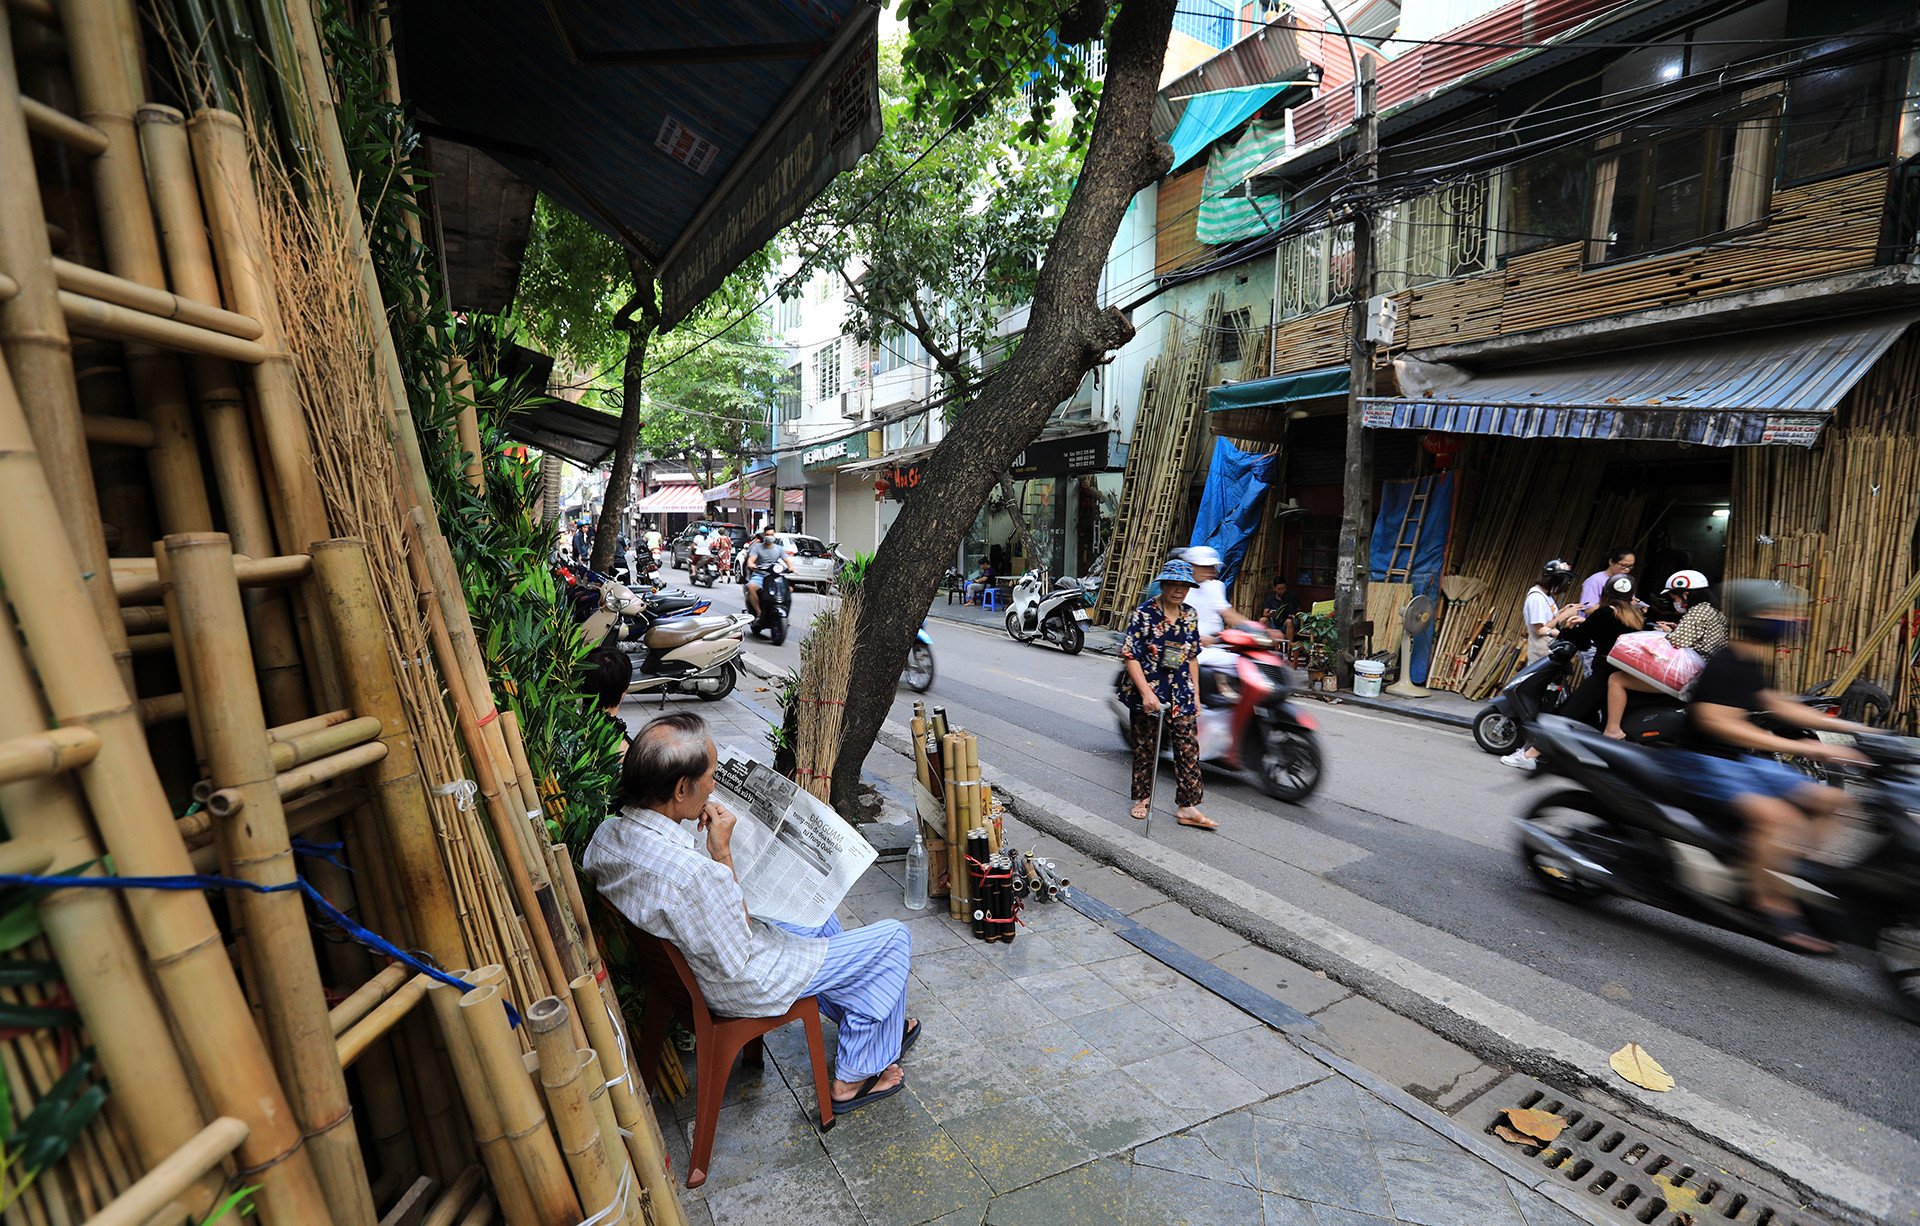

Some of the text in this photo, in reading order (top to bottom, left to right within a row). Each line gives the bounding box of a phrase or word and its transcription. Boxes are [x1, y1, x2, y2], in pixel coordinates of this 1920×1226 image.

[792, 812, 805, 824] trong
[822, 824, 844, 842] GUAM
[808, 833, 821, 847] Trung
[820, 843, 833, 855] Quốc
